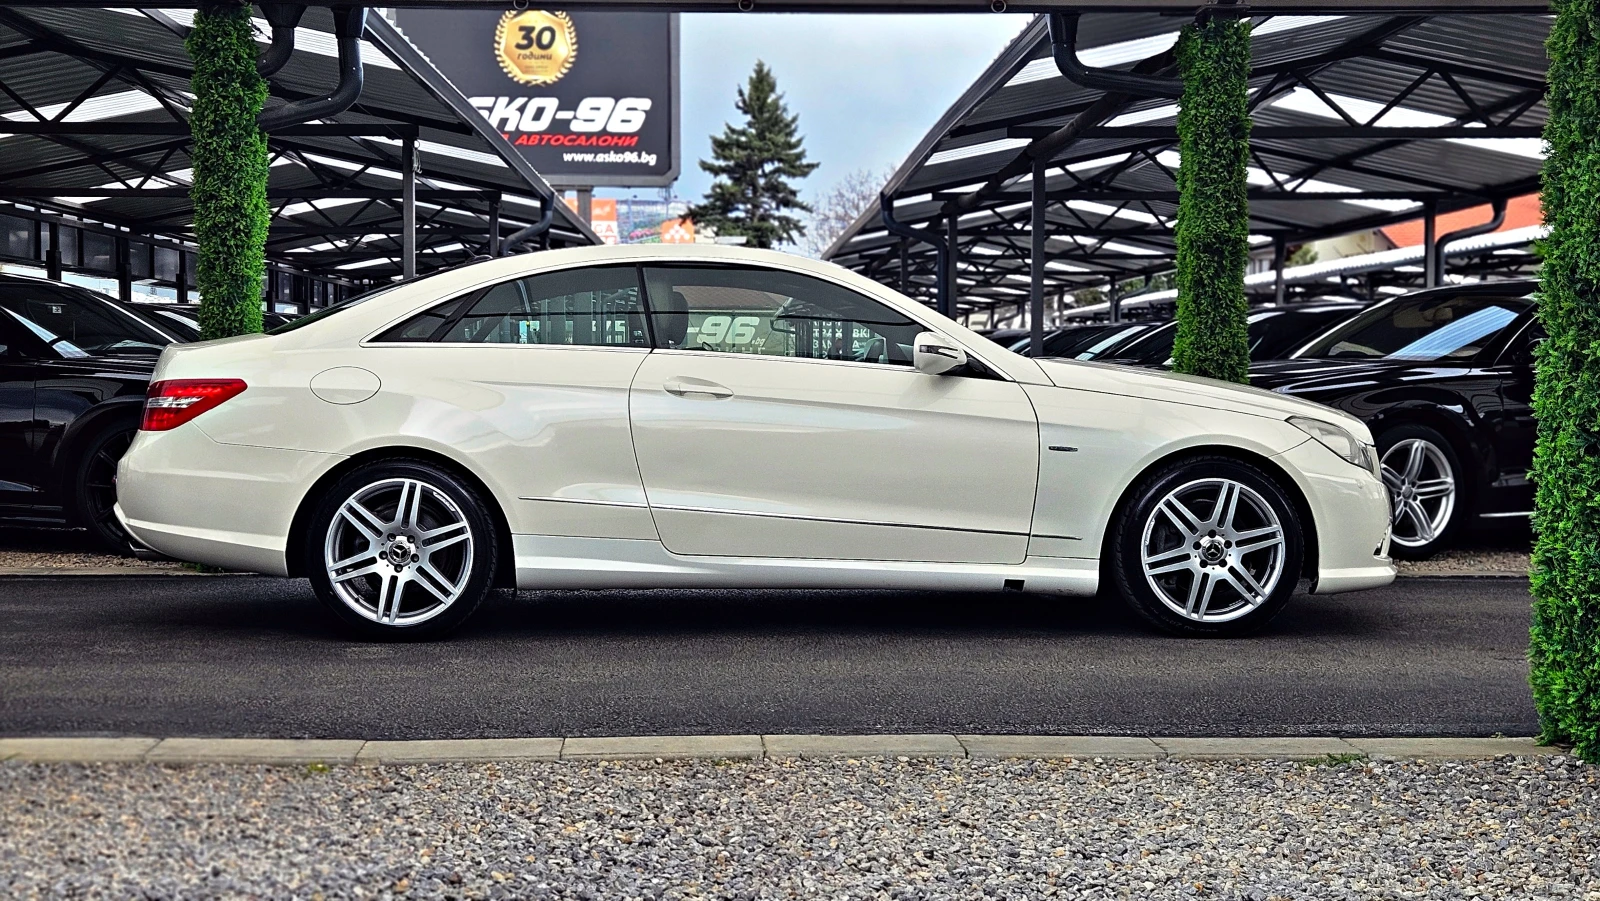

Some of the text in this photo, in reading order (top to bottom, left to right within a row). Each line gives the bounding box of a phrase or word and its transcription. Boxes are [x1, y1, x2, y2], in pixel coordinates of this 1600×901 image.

[514, 25, 556, 51] 30
[517, 51, 552, 60] години
[514, 134, 639, 147] АВТОСАЛОНИ
[562, 151, 657, 166] www.asko96.bg
